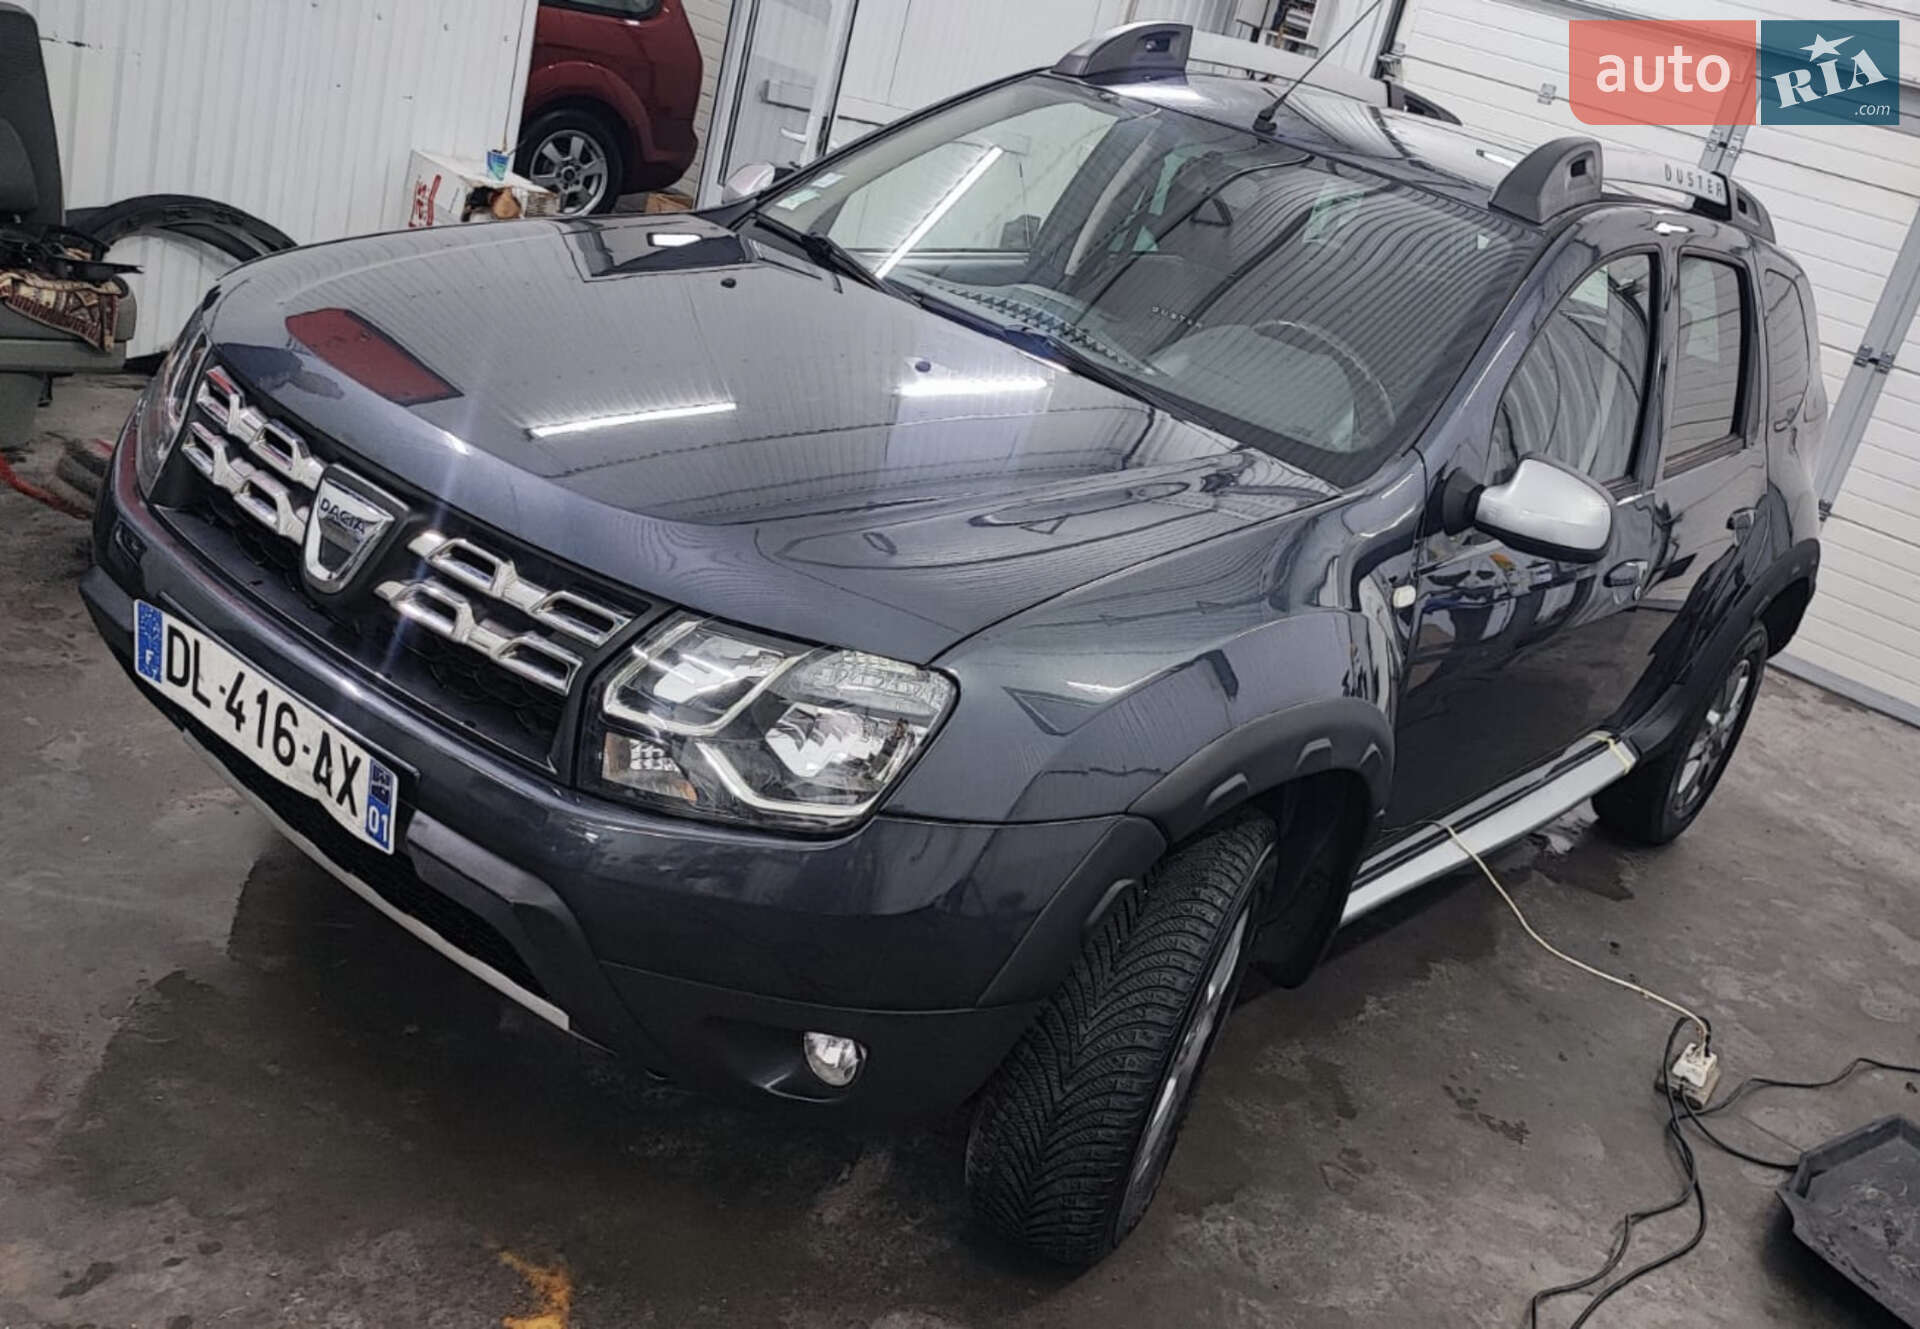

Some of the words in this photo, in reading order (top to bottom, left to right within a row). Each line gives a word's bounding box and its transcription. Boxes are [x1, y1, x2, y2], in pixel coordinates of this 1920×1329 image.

[1664, 163, 1722, 198] DUSTER
[320, 498, 365, 535] DACIA
[167, 624, 361, 818] DL-416-AX
[368, 805, 389, 843] 01
